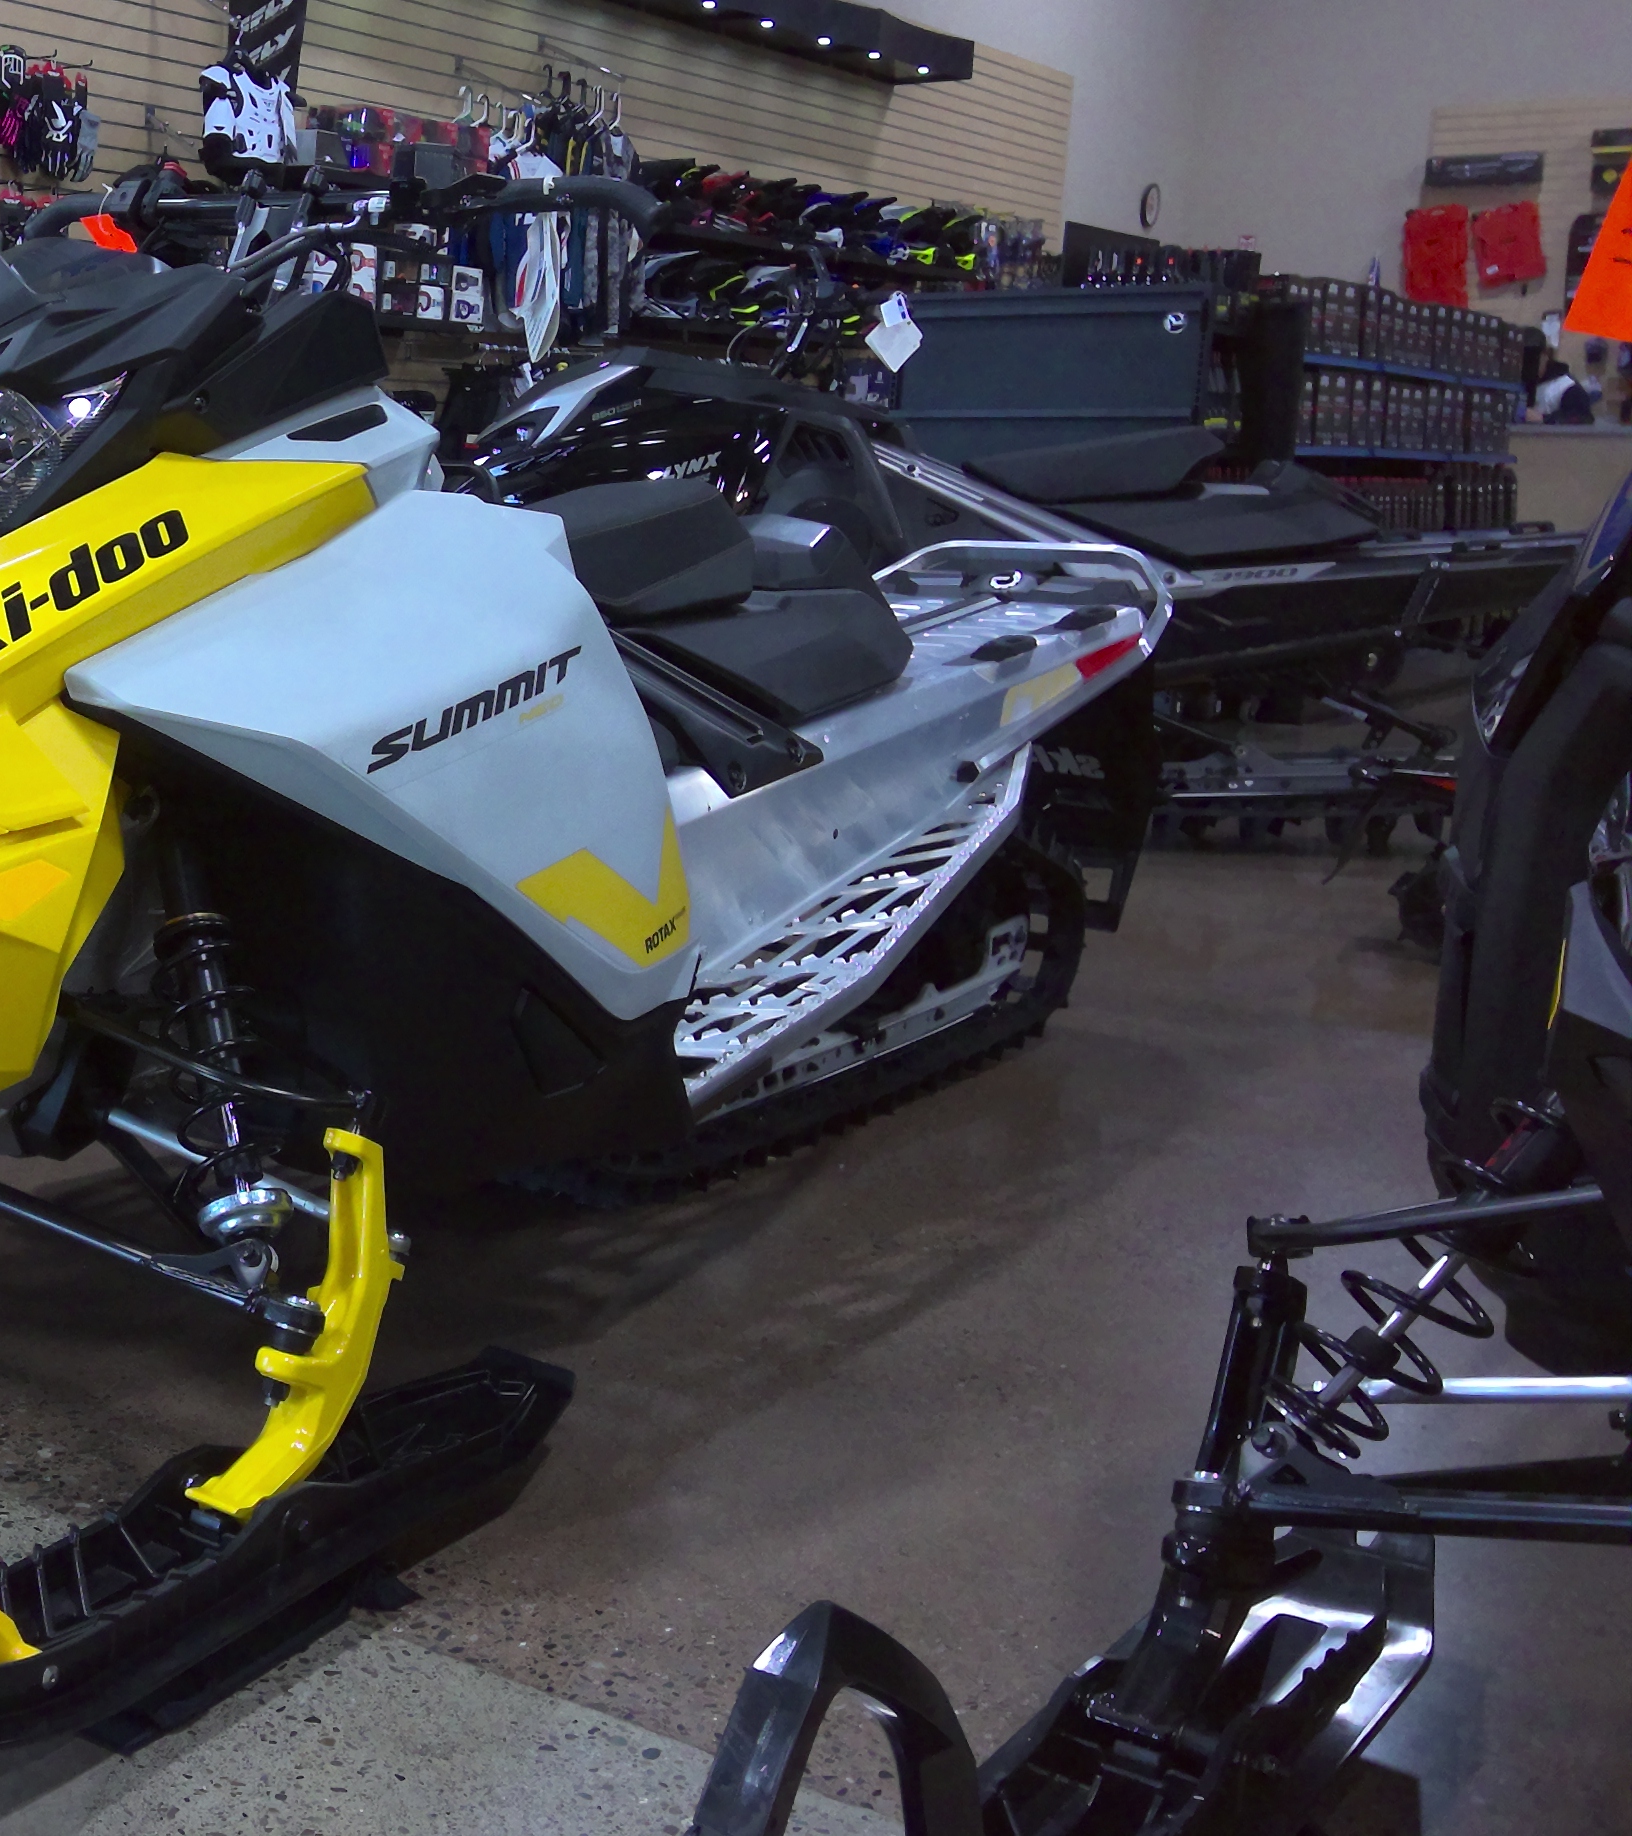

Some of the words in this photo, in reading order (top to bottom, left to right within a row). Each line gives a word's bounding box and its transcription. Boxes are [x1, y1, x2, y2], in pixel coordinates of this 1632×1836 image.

[662, 450, 722, 480] LYNX
[367, 645, 582, 774] SUMMIT
[645, 916, 676, 954] ROTAX
